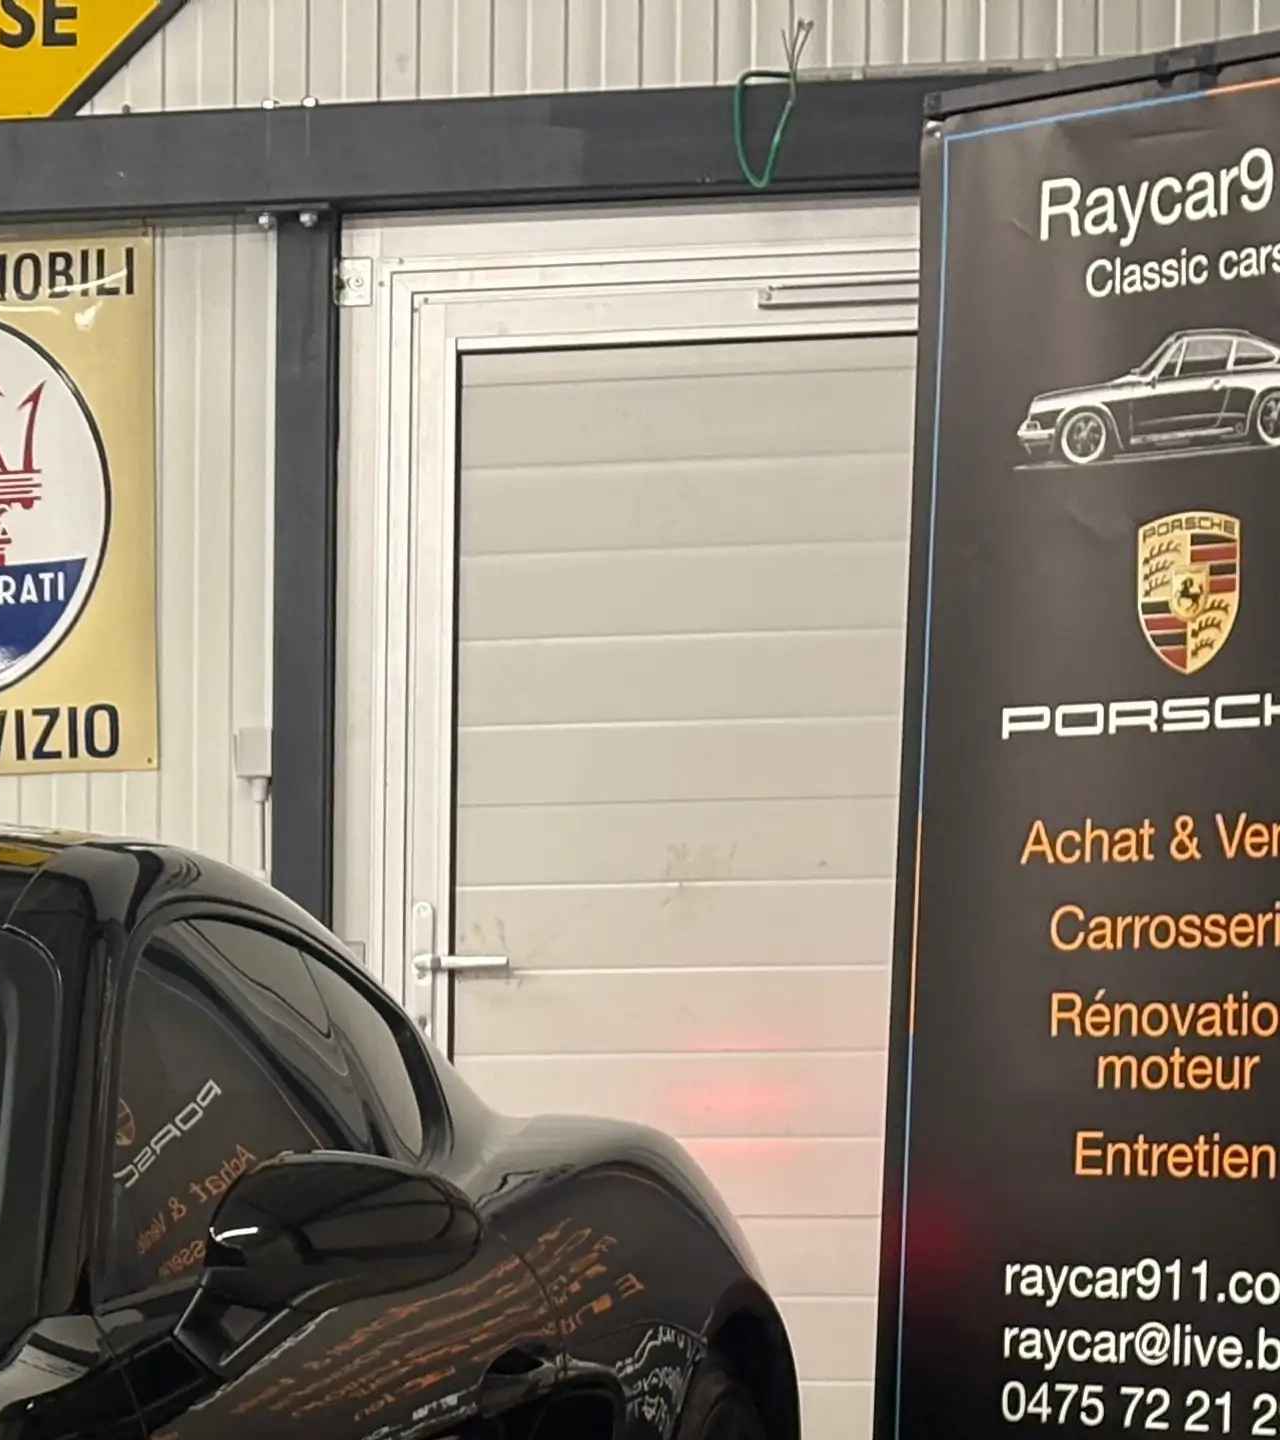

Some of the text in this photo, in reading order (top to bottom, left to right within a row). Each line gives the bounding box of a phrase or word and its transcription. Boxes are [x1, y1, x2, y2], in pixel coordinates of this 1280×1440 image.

[1040, 147, 1274, 248] Raycar9
[1086, 248, 1209, 298] Classic
[1143, 516, 1236, 542] PORSCHE
[1020, 818, 1155, 865] Achat
[1169, 815, 1202, 861] &
[1050, 900, 1280, 951] Carrosseri
[1050, 988, 1280, 1038] Rénovatio
[1097, 1046, 1261, 1090] moteur
[1074, 1130, 1277, 1180] Entretien
[1004, 1258, 1280, 1308] raycar911.co
[1003, 1321, 1280, 1372] raycar@live.b
[1001, 1380, 1106, 1427] 0475
[1120, 1386, 1171, 1431] 72
[1184, 1389, 1232, 1434] 21
